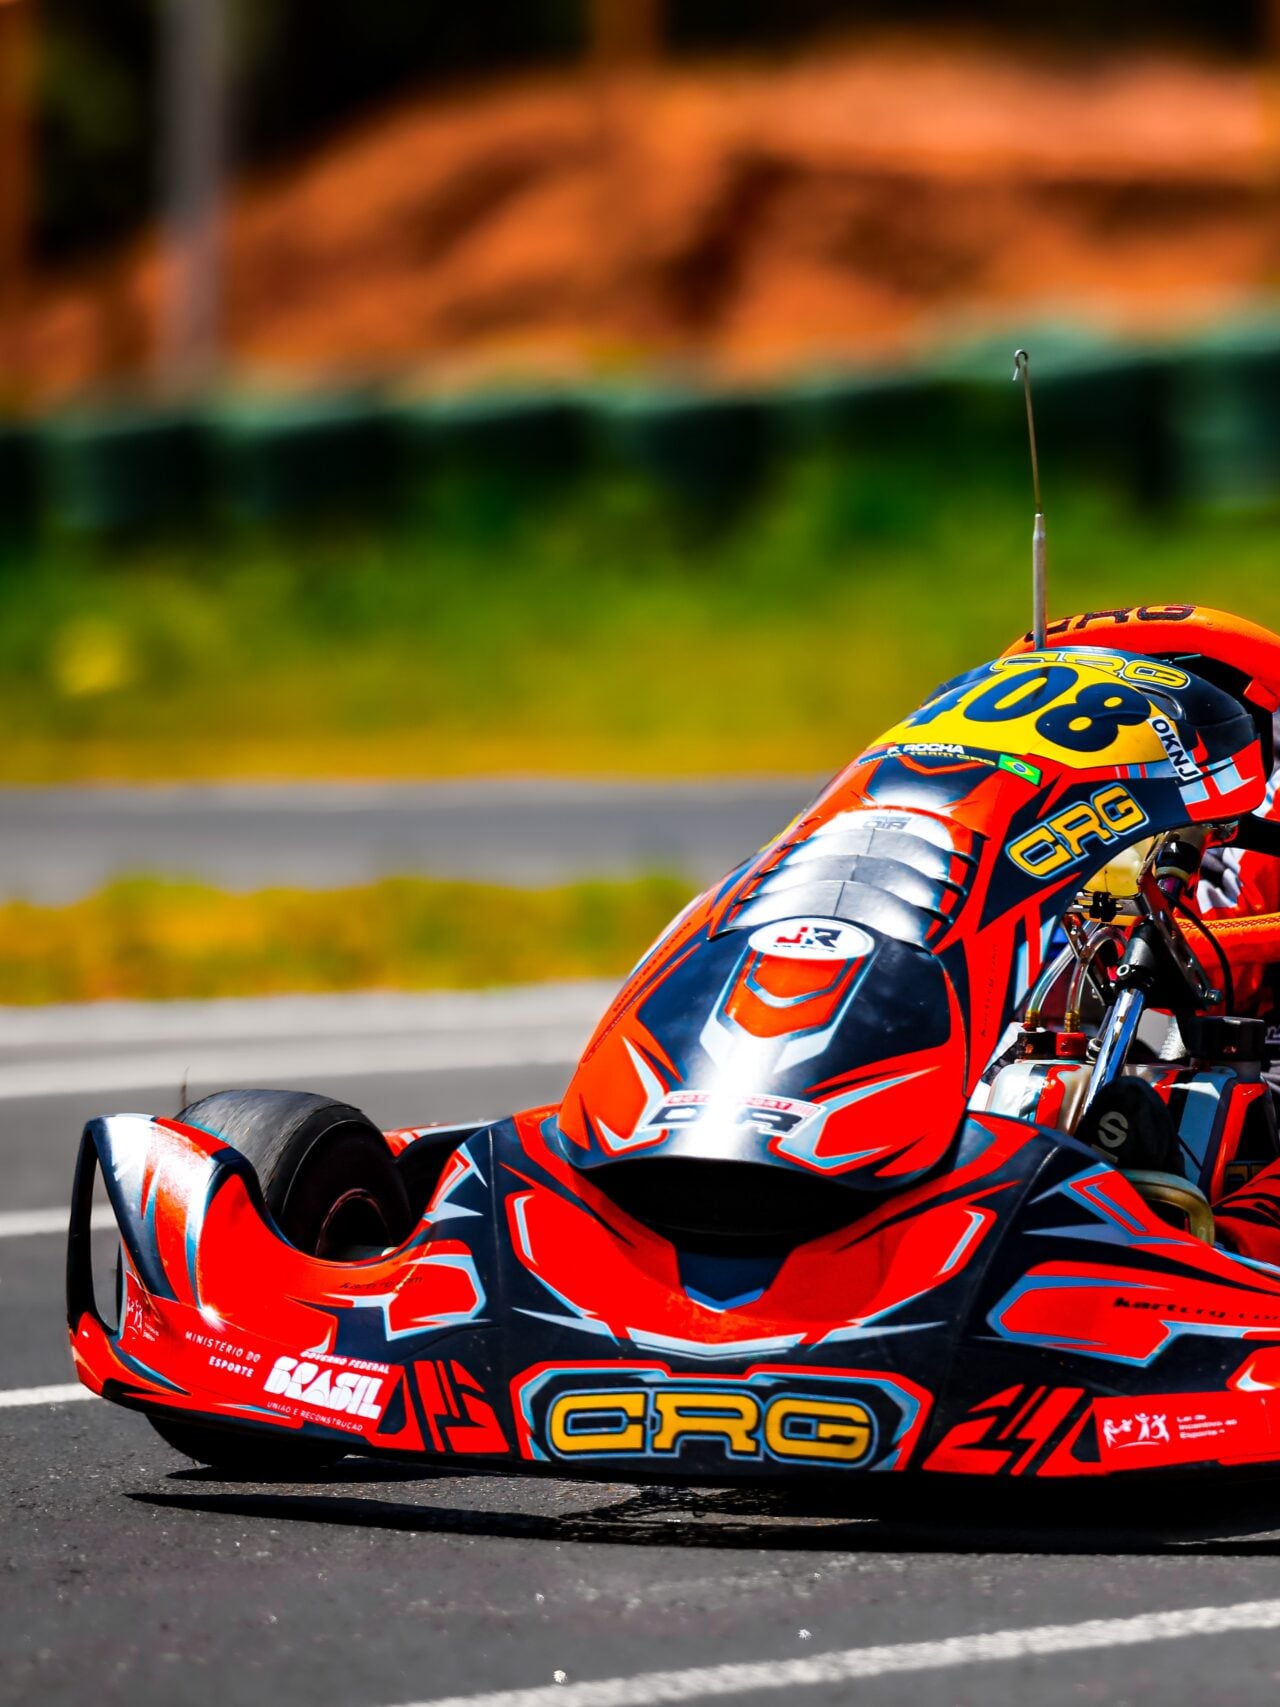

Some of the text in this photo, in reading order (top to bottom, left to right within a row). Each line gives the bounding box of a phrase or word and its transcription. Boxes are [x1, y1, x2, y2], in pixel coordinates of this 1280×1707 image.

[1024, 604, 1197, 643] CRG
[990, 651, 1190, 688] CRG
[906, 665, 1152, 752] 408
[902, 743, 965, 755] ROCHA
[1152, 718, 1200, 778] OKNJ
[1005, 782, 1149, 879] CRG
[184, 1330, 261, 1363] MINISTÉRIO DO
[300, 1350, 390, 1375] GOVERNO FEDERAL
[208, 1355, 255, 1378] ESPORTE
[263, 1355, 384, 1420] BRASIL
[547, 1388, 878, 1467] CRG
